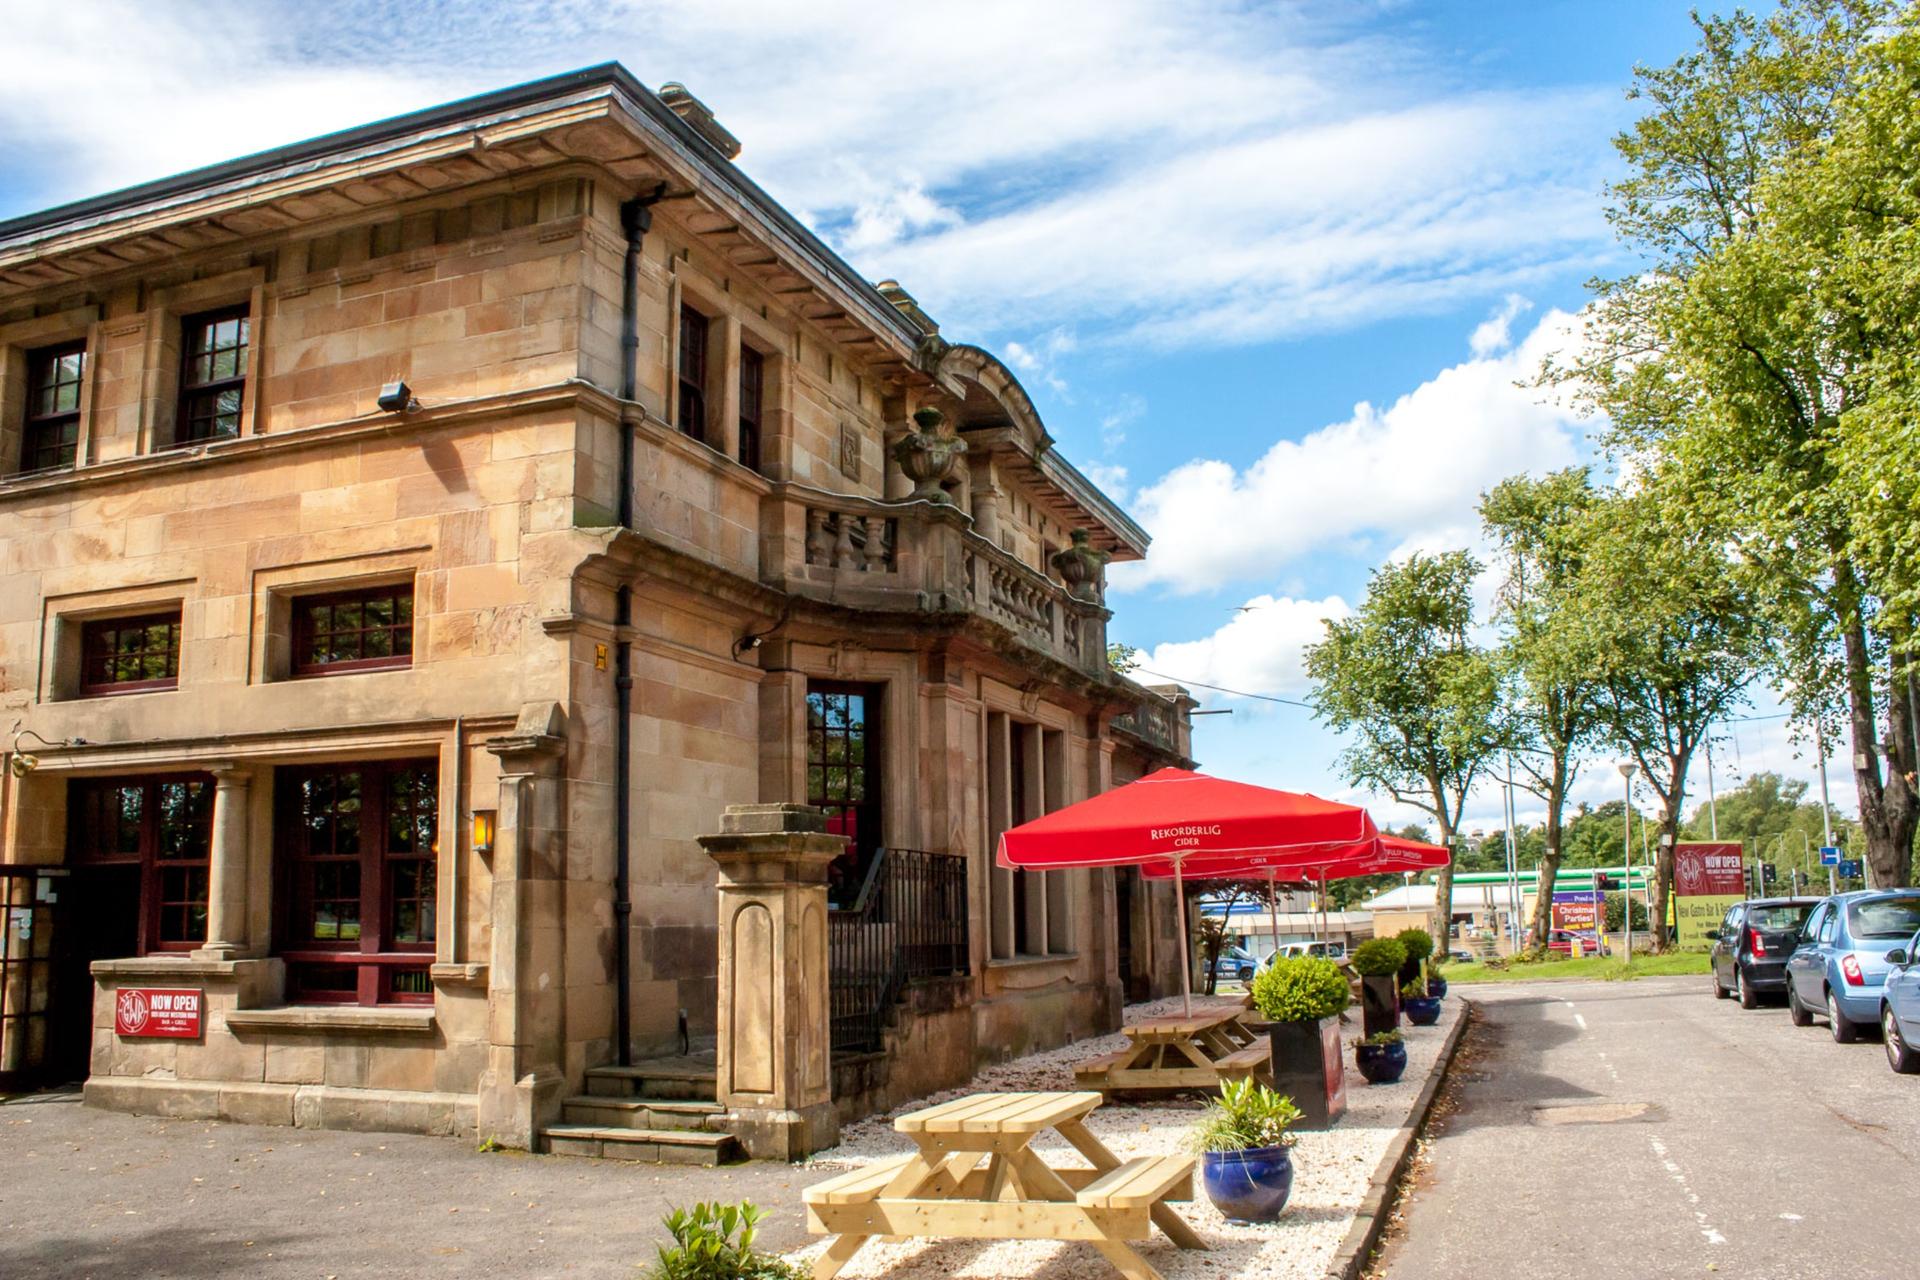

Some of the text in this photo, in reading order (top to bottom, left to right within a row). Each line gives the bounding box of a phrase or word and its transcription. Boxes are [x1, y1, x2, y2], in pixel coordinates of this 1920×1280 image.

[592, 642, 599, 657] H
[1151, 825, 1221, 840] REKORDERLIG
[1174, 838, 1200, 847] CIDER
[1705, 855, 1741, 868] NOW OPEN
[1564, 914, 1593, 923] Parties!
[151, 994, 198, 1011] NOW OPEN
[124, 996, 144, 1025] GWR
